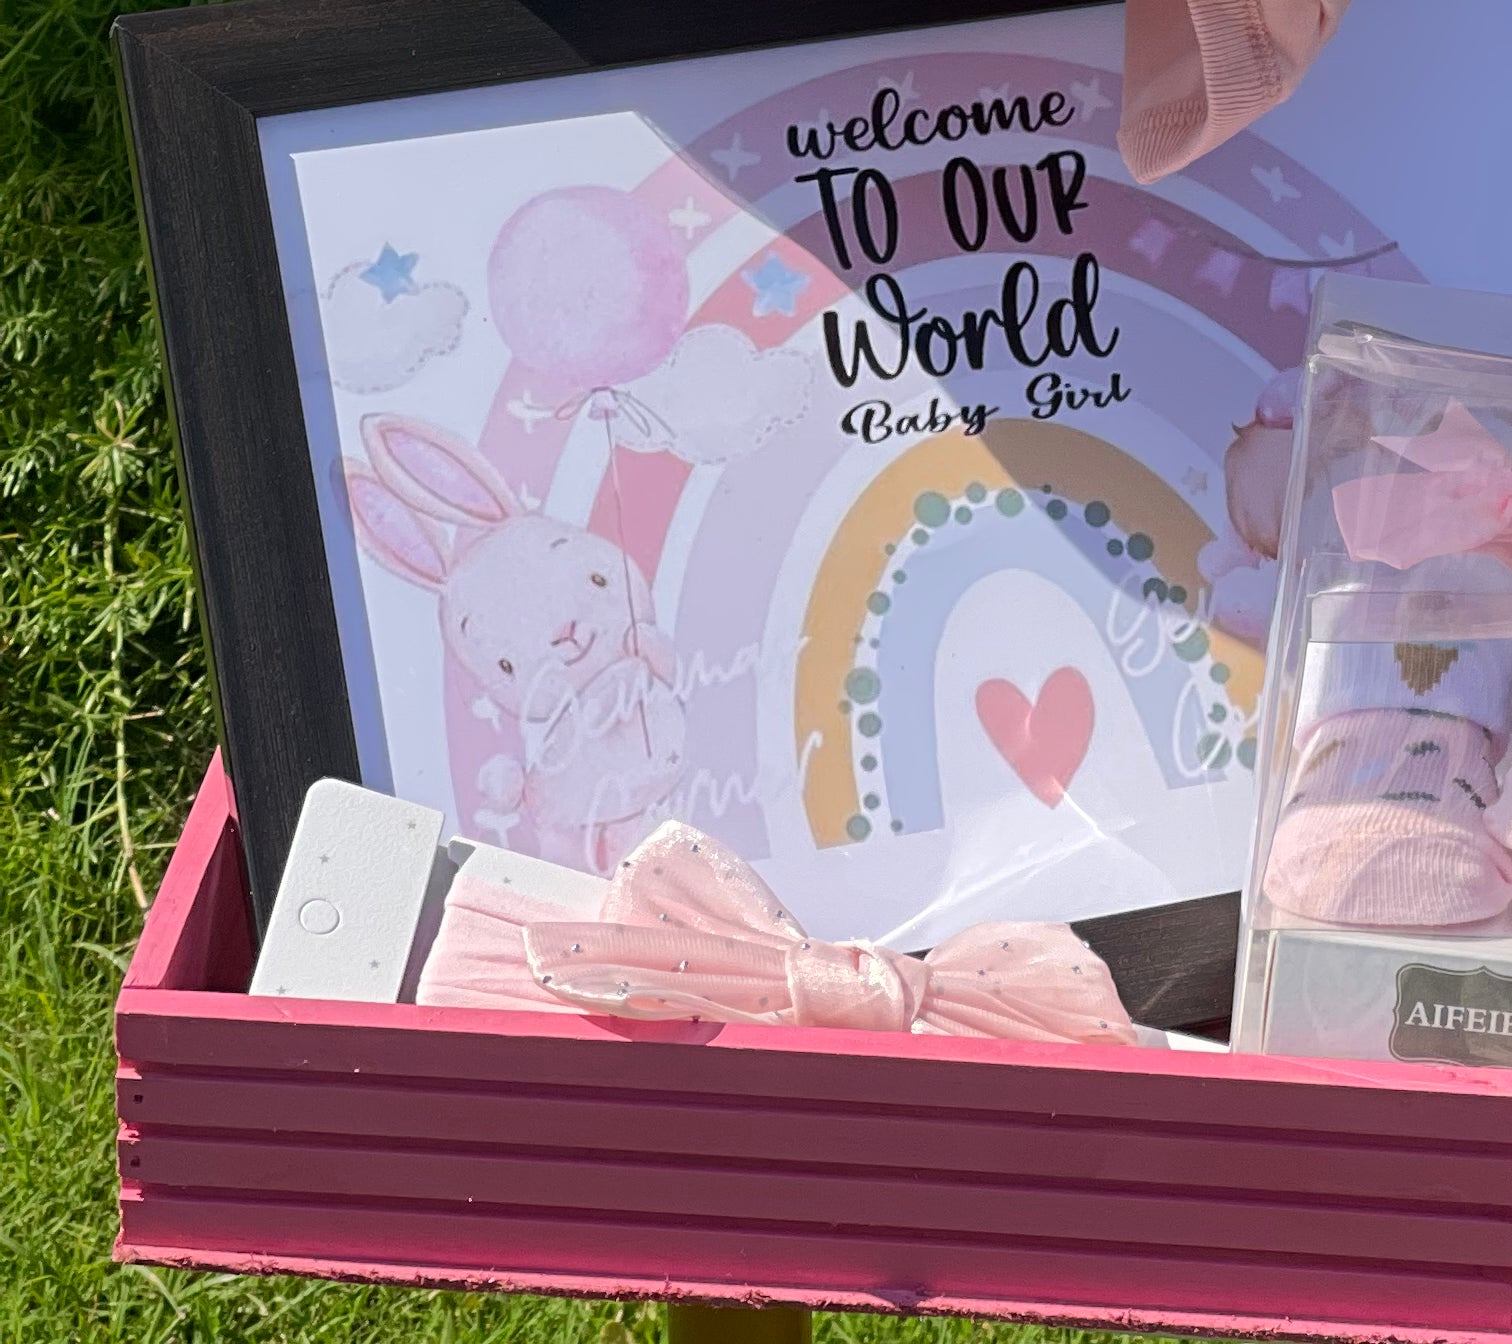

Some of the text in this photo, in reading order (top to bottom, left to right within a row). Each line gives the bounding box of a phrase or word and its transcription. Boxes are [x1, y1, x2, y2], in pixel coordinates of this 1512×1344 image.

[787, 87, 1076, 160] welcome
[794, 150, 1090, 271] TO OUR
[823, 252, 1120, 387] World
[840, 372, 1131, 444] Baby Girl
